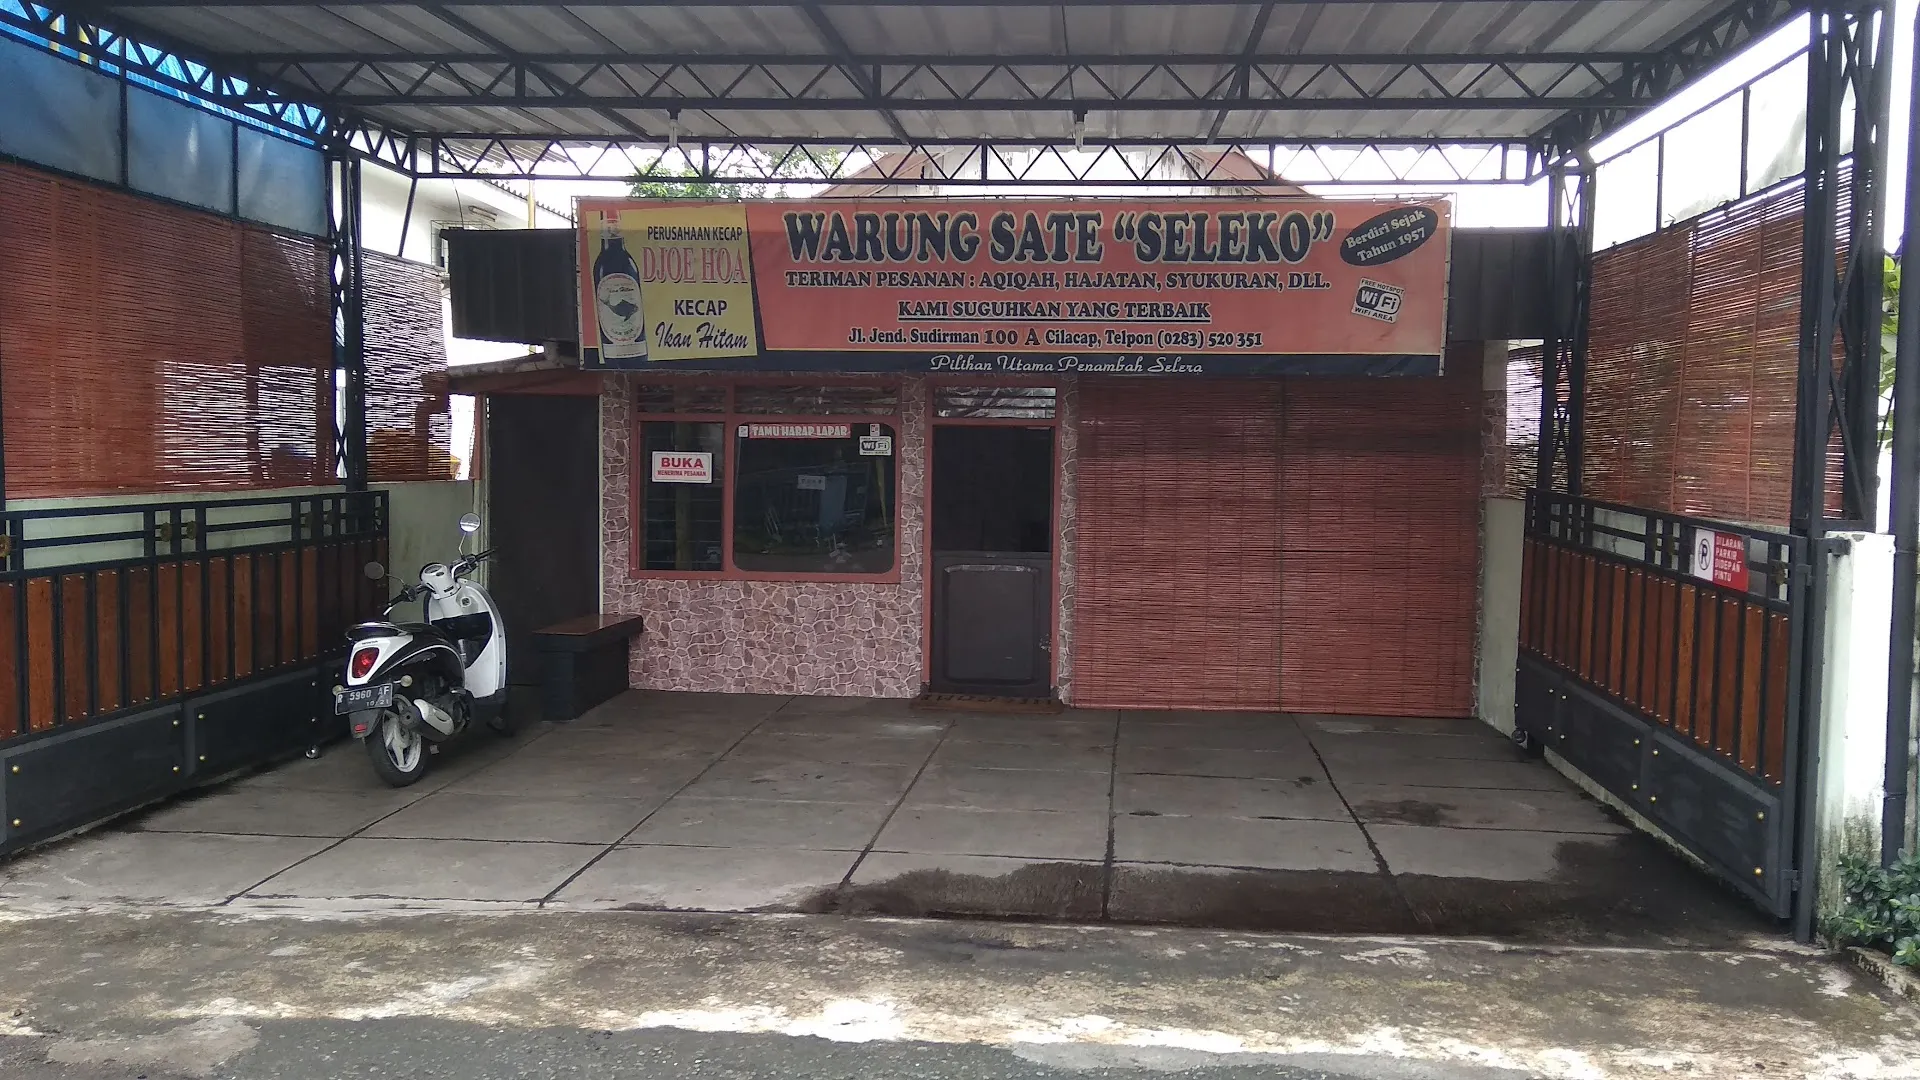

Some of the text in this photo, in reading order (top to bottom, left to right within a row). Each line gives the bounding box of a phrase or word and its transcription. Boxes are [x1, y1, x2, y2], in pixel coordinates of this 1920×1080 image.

[647, 225, 743, 241] PERUSAHAAN KECAP
[782, 211, 981, 263] WARUNG
[988, 211, 1104, 263] SATE
[1345, 209, 1426, 249] Berdiri Sejak
[1356, 226, 1426, 262] Tahun 1957
[642, 246, 748, 283] DJOE HOA
[785, 271, 871, 288] TERIMAN
[876, 271, 965, 288] PESANAN
[978, 271, 1060, 291] AQIQAH,
[1064, 272, 1162, 292] HAJATAN,
[1165, 273, 1284, 292] SYUKURAN,
[1287, 274, 1332, 290] DLL.
[1361, 279, 1405, 295] FREE HOTSPOT
[673, 299, 727, 316] KECAP
[898, 301, 1211, 320] KAMI SUGUHKAN YANG TERBAIK
[1372, 310, 1394, 322] AREA
[655, 321, 748, 349] Ikan Hitam
[869, 328, 907, 344] Jend.
[910, 329, 979, 345] Sudirman
[983, 328, 1019, 345] 100
[1024, 328, 1041, 346] A
[1044, 329, 1102, 348] Cilacap,
[1104, 328, 1154, 349] Telpon
[1157, 329, 1205, 350] (0283)
[1207, 331, 1234, 348] 520
[1236, 332, 1263, 349] 351
[930, 354, 1203, 374] Pilihan Utama Penambah Selera
[752, 426, 780, 437] TAMU
[781, 426, 815, 438] HARAP
[816, 426, 849, 437] LAPAR
[661, 457, 705, 469] BUKA
[1715, 547, 1738, 560] PARKIR
[1714, 558, 1742, 572] DIDEPAN
[1714, 569, 1732, 582] PINTU
[337, 686, 390, 704] R 5960 AF
